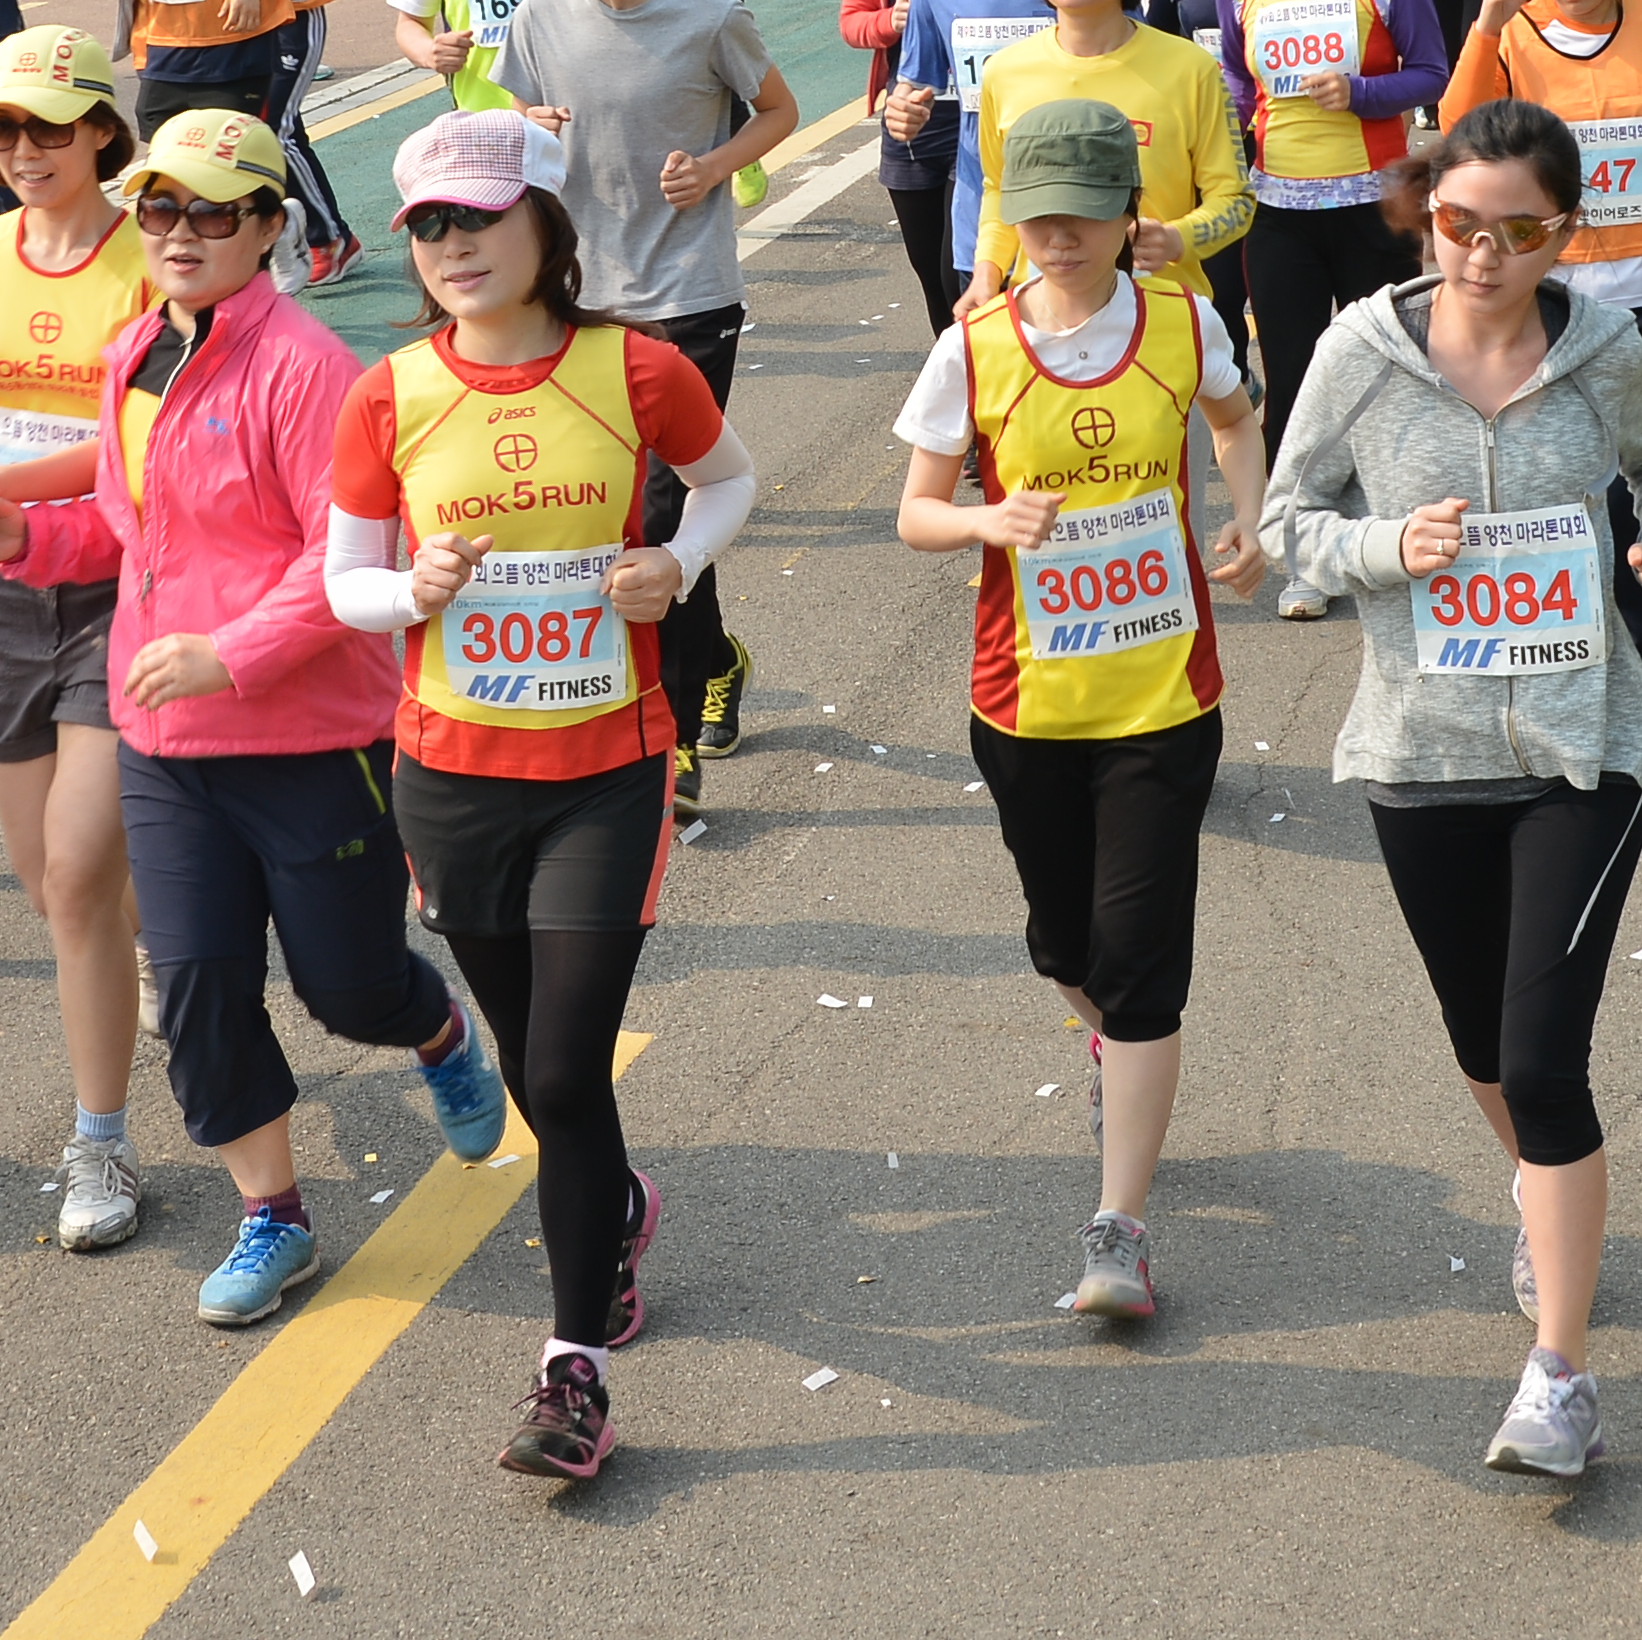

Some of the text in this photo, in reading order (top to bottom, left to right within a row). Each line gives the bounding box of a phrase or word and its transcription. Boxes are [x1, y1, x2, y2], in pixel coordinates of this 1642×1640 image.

[1309, 3, 1352, 19] 마라톤대회
[1263, 32, 1345, 71] 3088
[1578, 127, 1598, 145] 양천
[1588, 158, 1638, 194] 47
[34, 353, 56, 381] 5
[0, 416, 25, 439] 으뜸
[26, 418, 50, 444] 양천
[504, 406, 537, 420] asics
[1021, 455, 1169, 491] MOK 5 RUN
[436, 479, 607, 526] MOK 5 RUN
[1054, 501, 1171, 544] 으뜸 양천 마라톤대회
[1483, 522, 1513, 547] 양천
[1516, 511, 1588, 542] 마라톤대회
[491, 563, 519, 586] 으뜸
[522, 560, 549, 584] 양천
[1036, 548, 1169, 615] 3086
[1427, 570, 1578, 628] 3084
[461, 605, 604, 664] 3087
[1048, 607, 1184, 652] MF FITNESS
[1437, 636, 1590, 669] MF FITNESS
[466, 672, 612, 703] MF FITNESS
